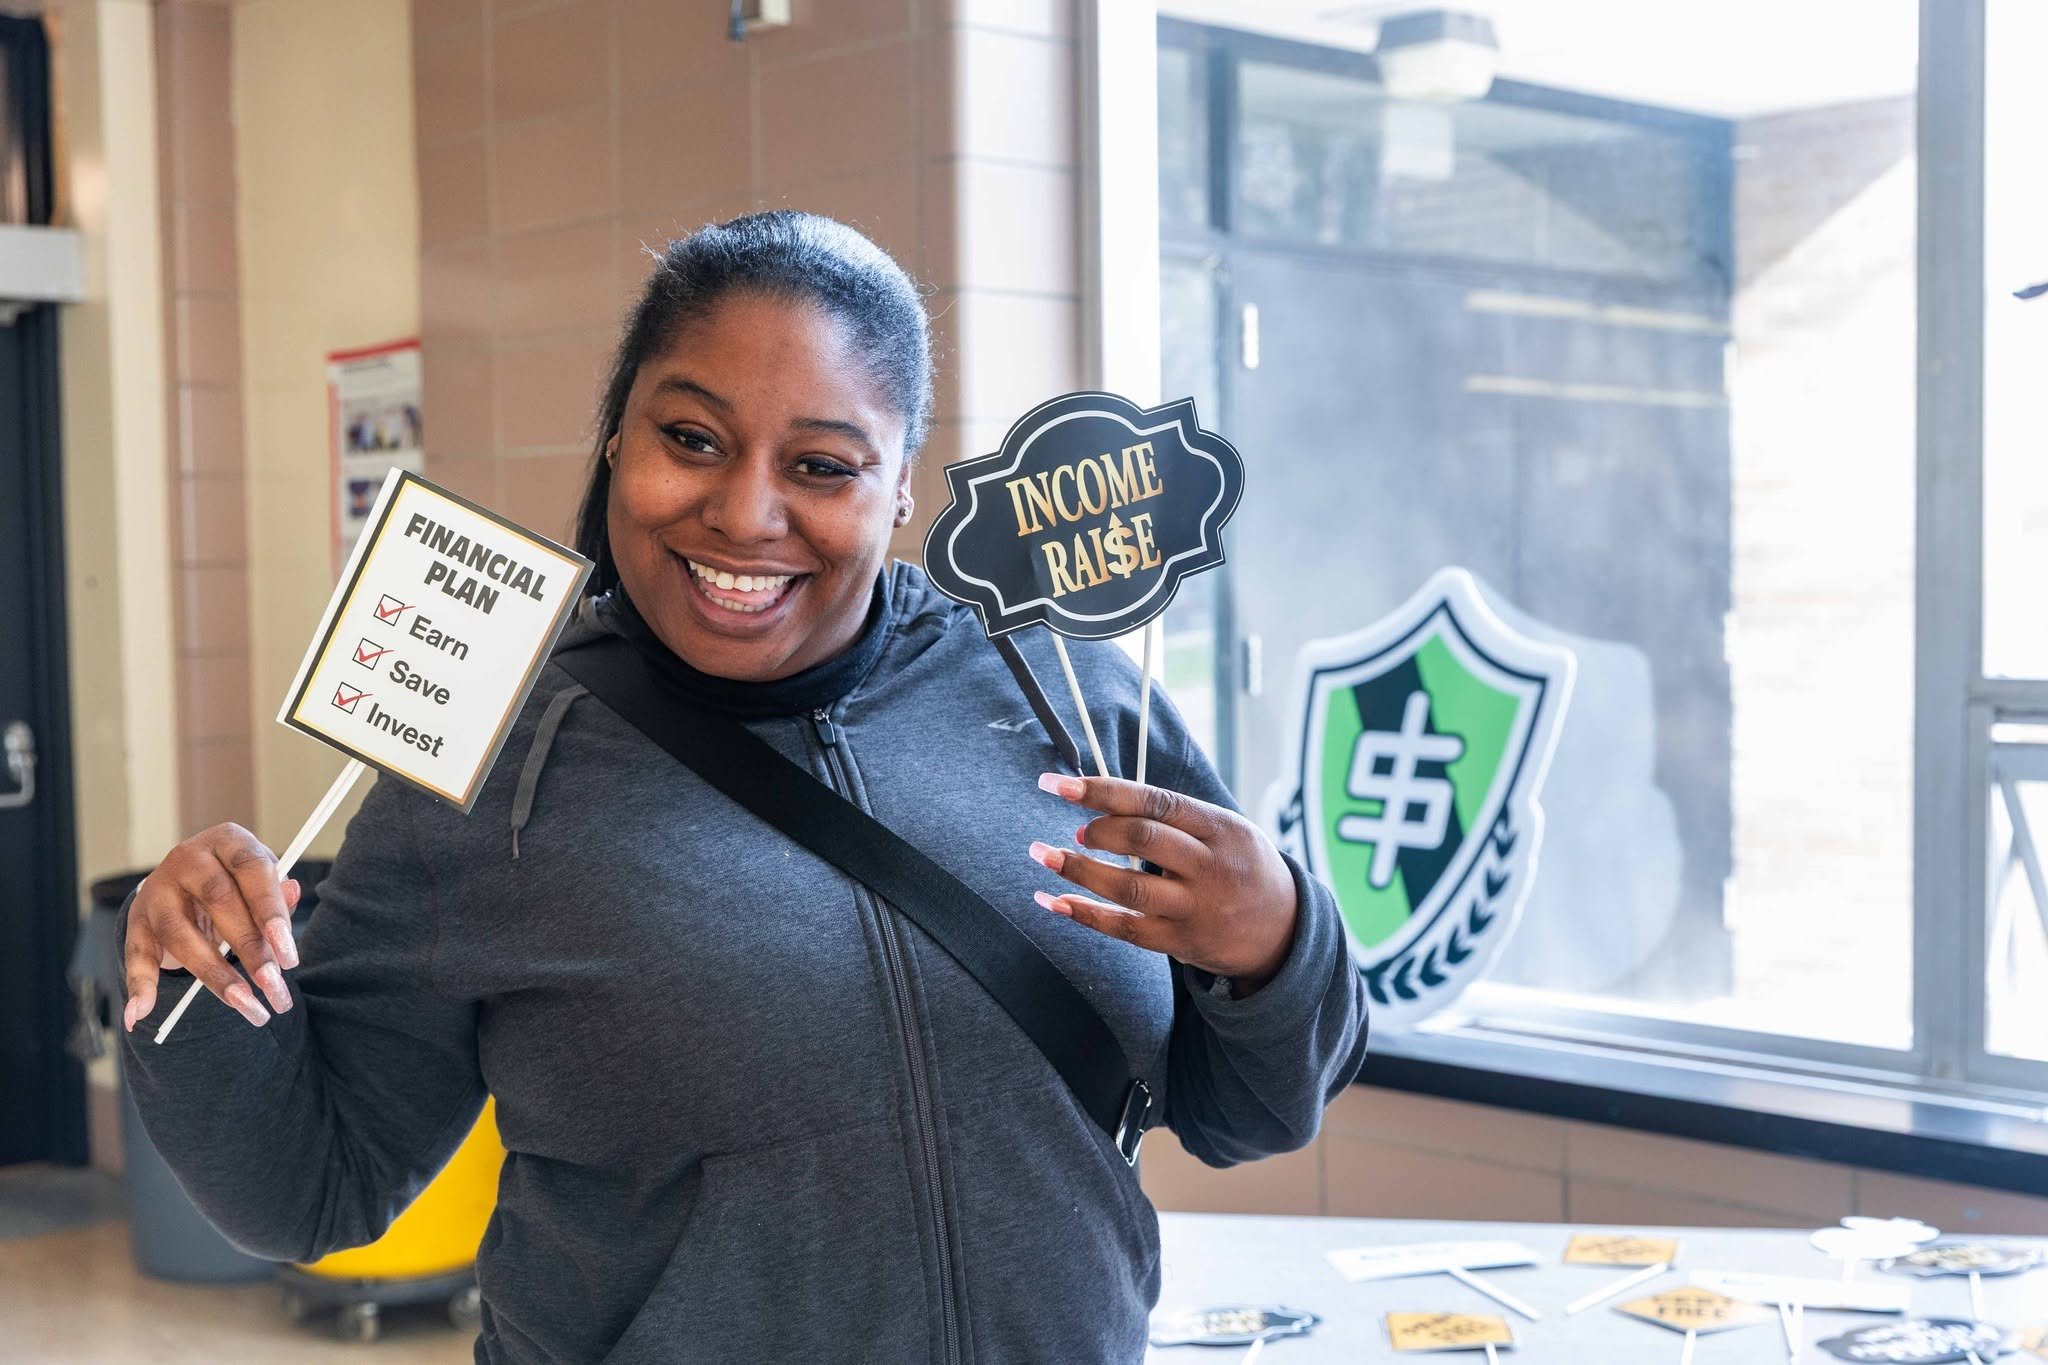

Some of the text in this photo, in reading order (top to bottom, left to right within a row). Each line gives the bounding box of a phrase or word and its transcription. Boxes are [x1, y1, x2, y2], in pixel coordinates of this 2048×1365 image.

[1005, 441, 1163, 537] INCOME
[404, 513, 546, 601] FINANCIAL
[424, 561, 500, 614] PLAN
[409, 615, 470, 660] Earn
[389, 660, 451, 705] Save
[366, 703, 444, 758] Invest
